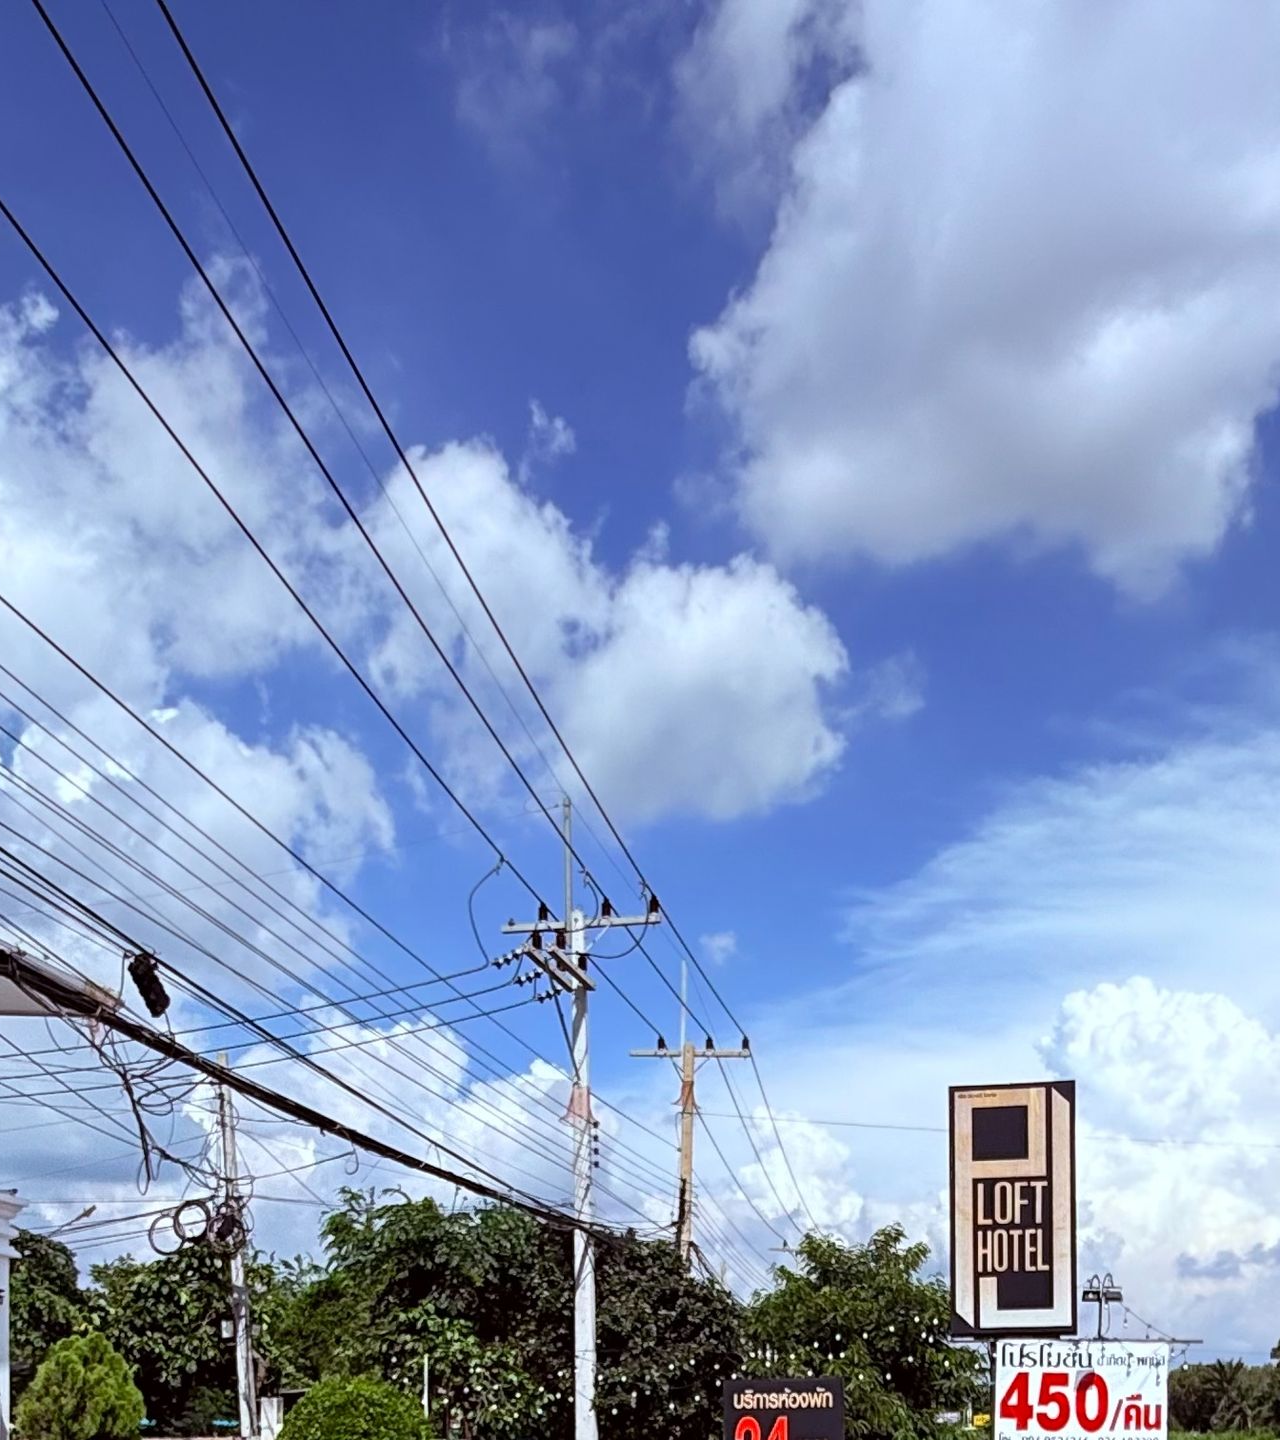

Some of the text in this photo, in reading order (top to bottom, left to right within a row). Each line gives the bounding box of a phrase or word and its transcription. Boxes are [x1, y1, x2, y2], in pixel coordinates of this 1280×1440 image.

[977, 1181, 1048, 1226] LOFT
[977, 1228, 1050, 1273] HOTEL
[733, 1387, 834, 1409] บริการห้องพัก
